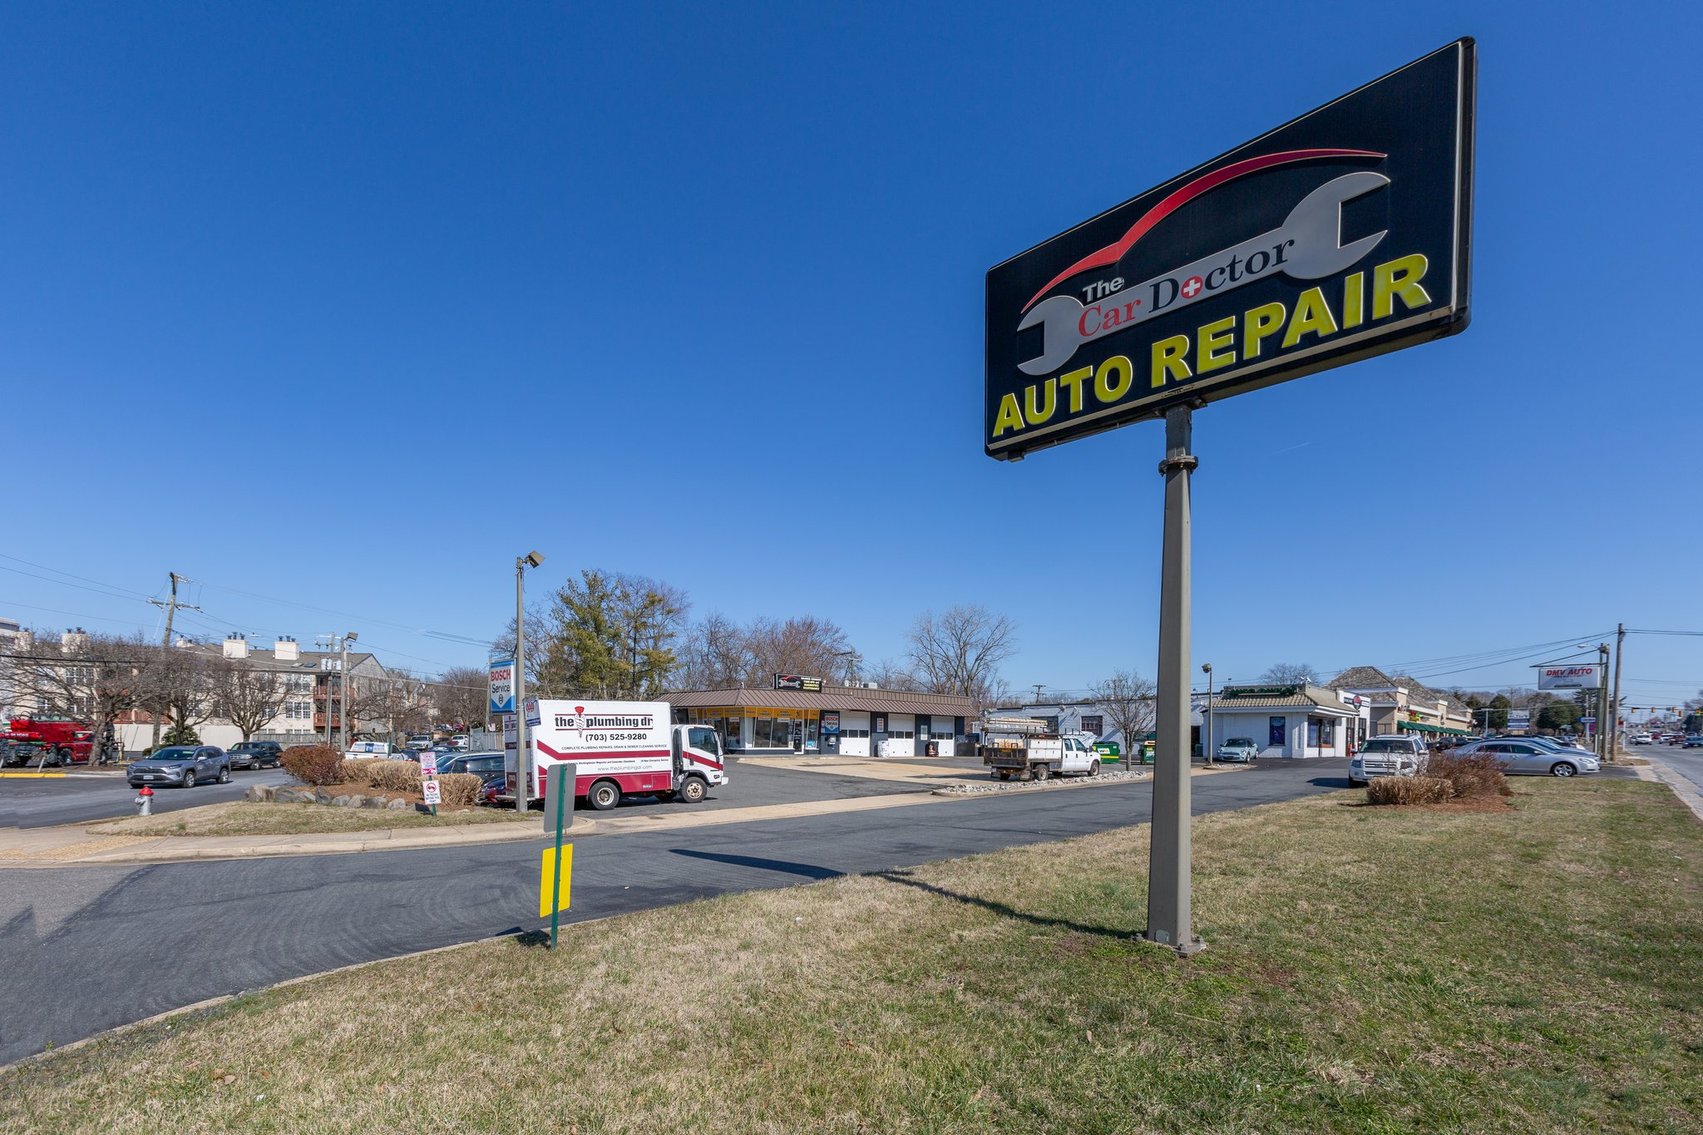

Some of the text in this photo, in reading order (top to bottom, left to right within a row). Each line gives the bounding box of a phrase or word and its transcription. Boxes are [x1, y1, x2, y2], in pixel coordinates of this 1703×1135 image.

[1081, 276, 1125, 303] The
[1078, 299, 1142, 337] Car
[992, 254, 1433, 437] AUTO REPAIR
[490, 669, 511, 682] BOSCH
[491, 683, 510, 694] Service
[555, 716, 574, 727] the
[586, 716, 639, 728] plumbing
[585, 733, 647, 742] (703) 525-9280
